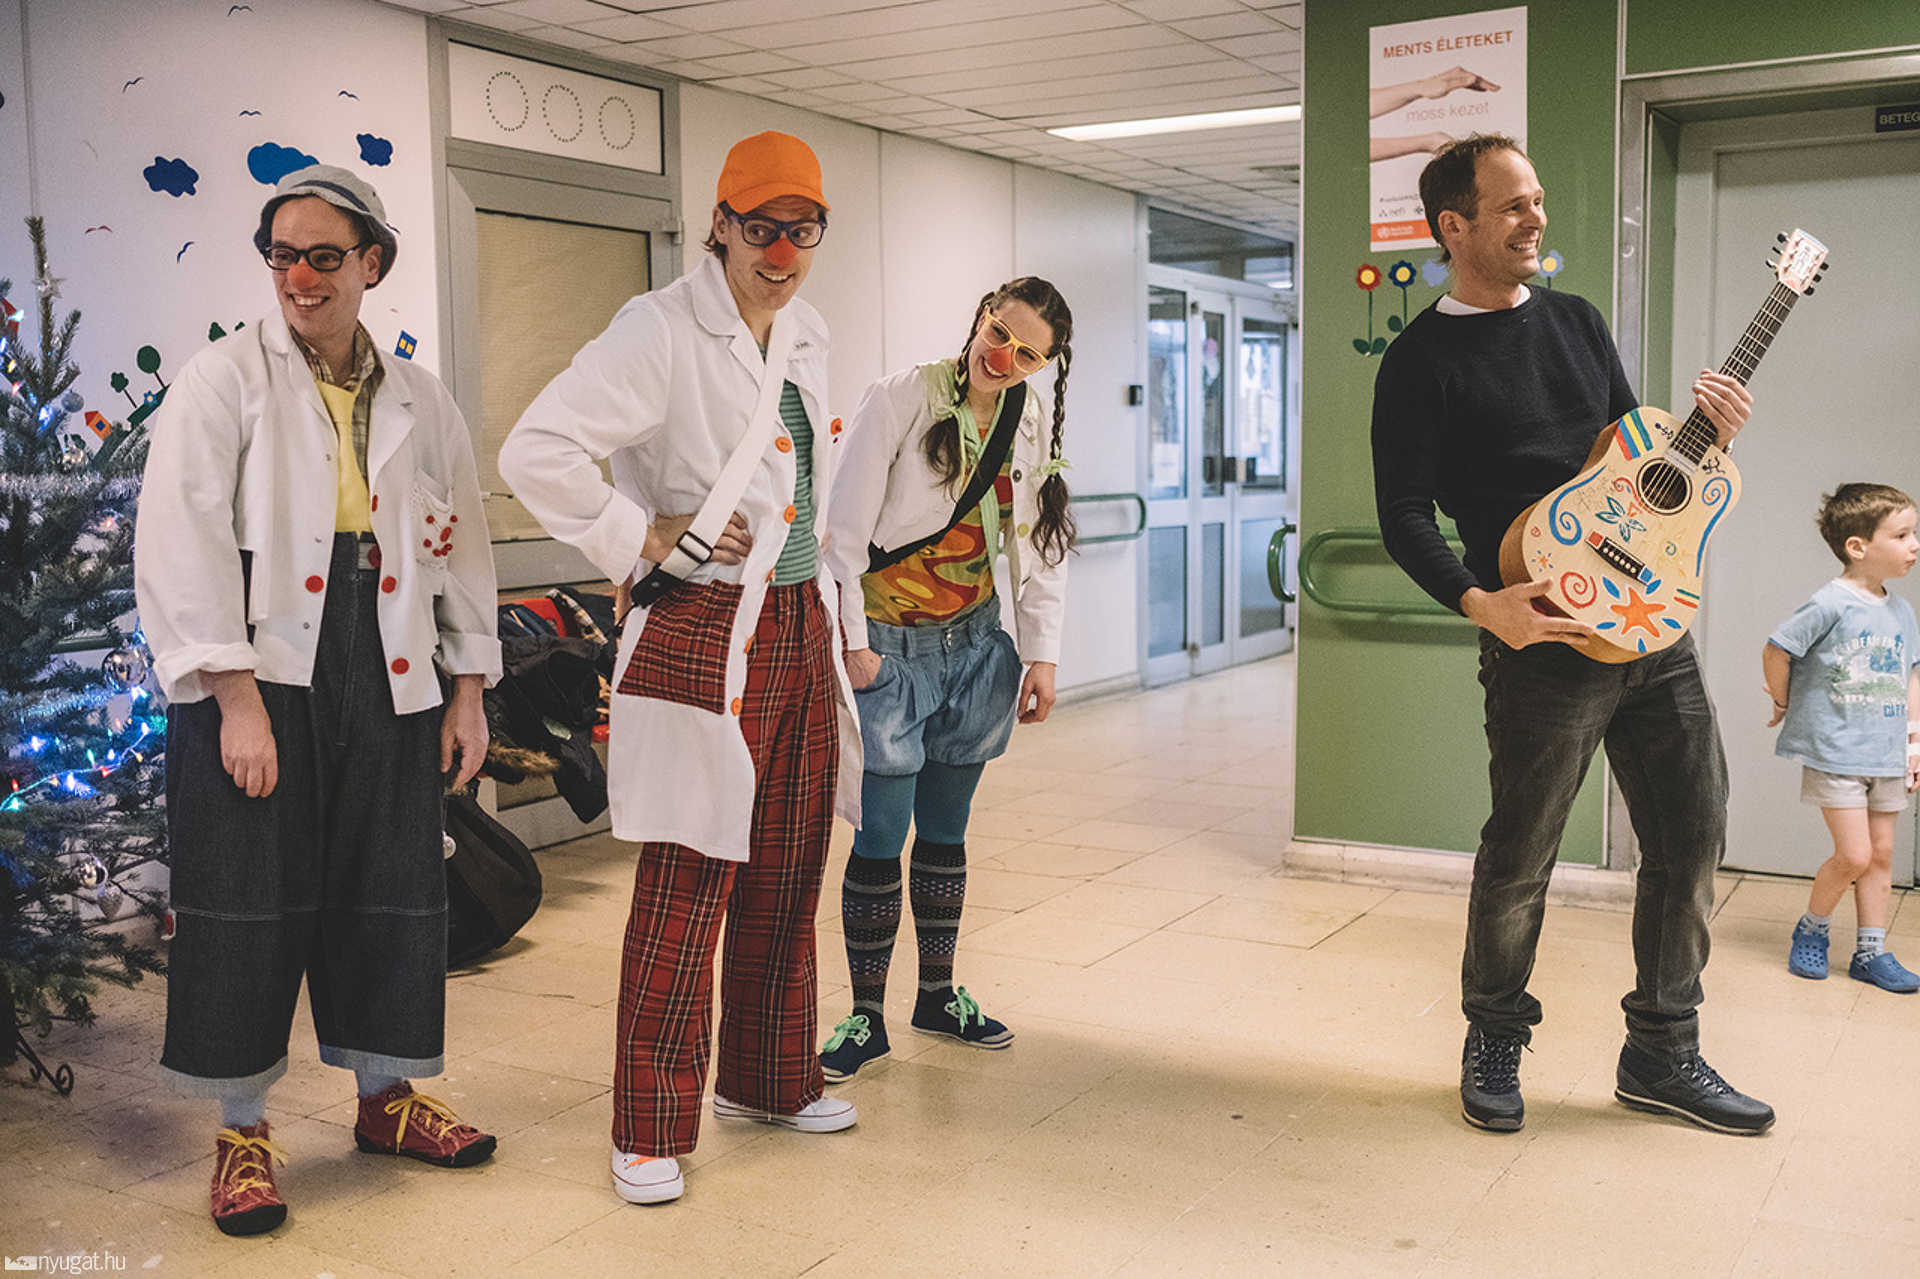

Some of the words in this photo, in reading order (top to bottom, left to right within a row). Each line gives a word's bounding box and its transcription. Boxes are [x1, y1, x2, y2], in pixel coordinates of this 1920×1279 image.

[1383, 41, 1433, 58] MENTS
[1436, 30, 1513, 51] ÉLETEKET
[1406, 107, 1446, 121] moss
